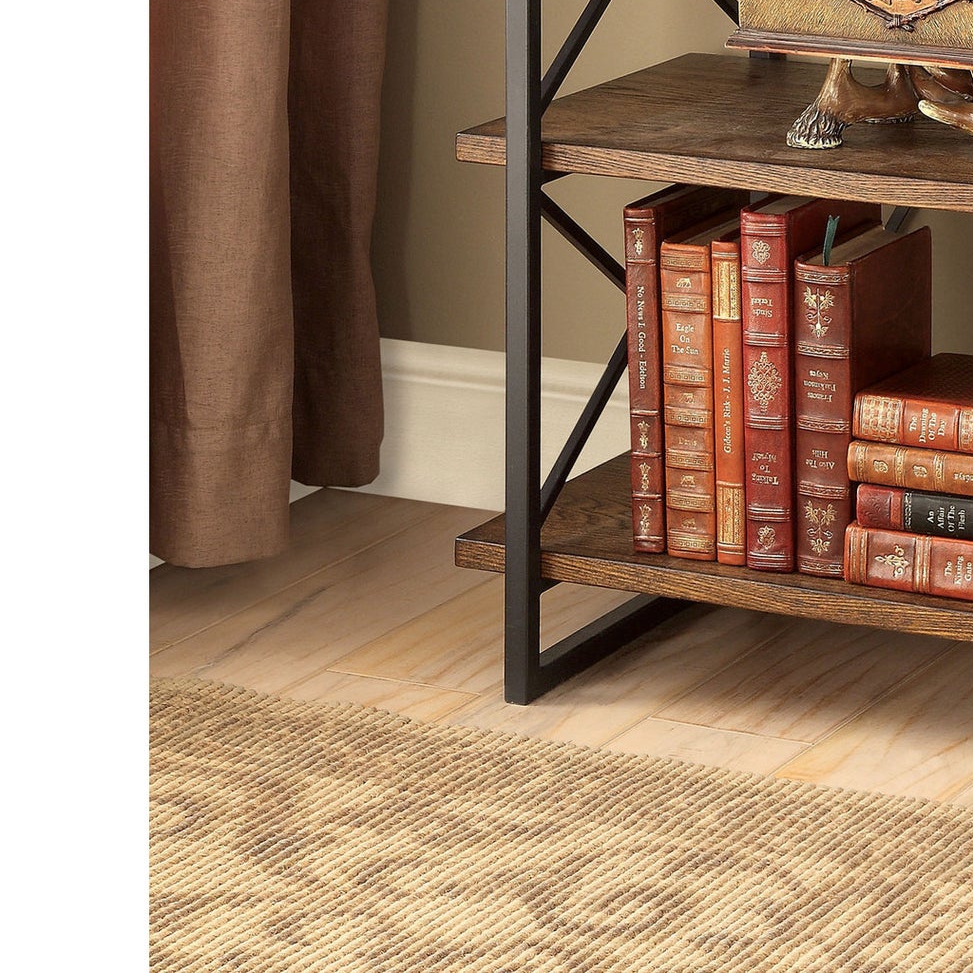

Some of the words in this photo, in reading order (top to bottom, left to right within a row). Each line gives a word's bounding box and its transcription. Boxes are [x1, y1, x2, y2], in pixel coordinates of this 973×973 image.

[637, 286, 645, 298] No
[637, 300, 645, 320] News
[675, 323, 695, 334] Eagle
[638, 331, 647, 353] Good
[679, 334, 690, 344] On
[671, 344, 685, 354] The
[685, 345, 699, 355] Sun
[639, 361, 647, 390] Edelson
[723, 373, 731, 384] J.
[809, 370, 829, 380] Keyes
[723, 383, 731, 393] J.
[803, 380, 836, 391] Parkinson
[807, 392, 832, 402] Frances
[723, 401, 731, 418] Risk
[909, 416, 918, 432] The
[928, 413, 937, 428] The
[928, 429, 936, 441] Of
[937, 419, 947, 437] Day
[723, 420, 732, 454] Gideon's
[751, 452, 777, 463] Myself
[805, 458, 818, 468] The
[759, 464, 771, 473] To
[820, 461, 835, 470] Also
[751, 472, 779, 486] Talking
[927, 510, 934, 524] An
[937, 506, 945, 529] Affair
[947, 505, 956, 521] The
[958, 509, 966, 530] Flesh
[947, 521, 955, 533] Of
[944, 561, 953, 576] The
[953, 555, 964, 585] Kissing
[964, 561, 972, 581] Gate
